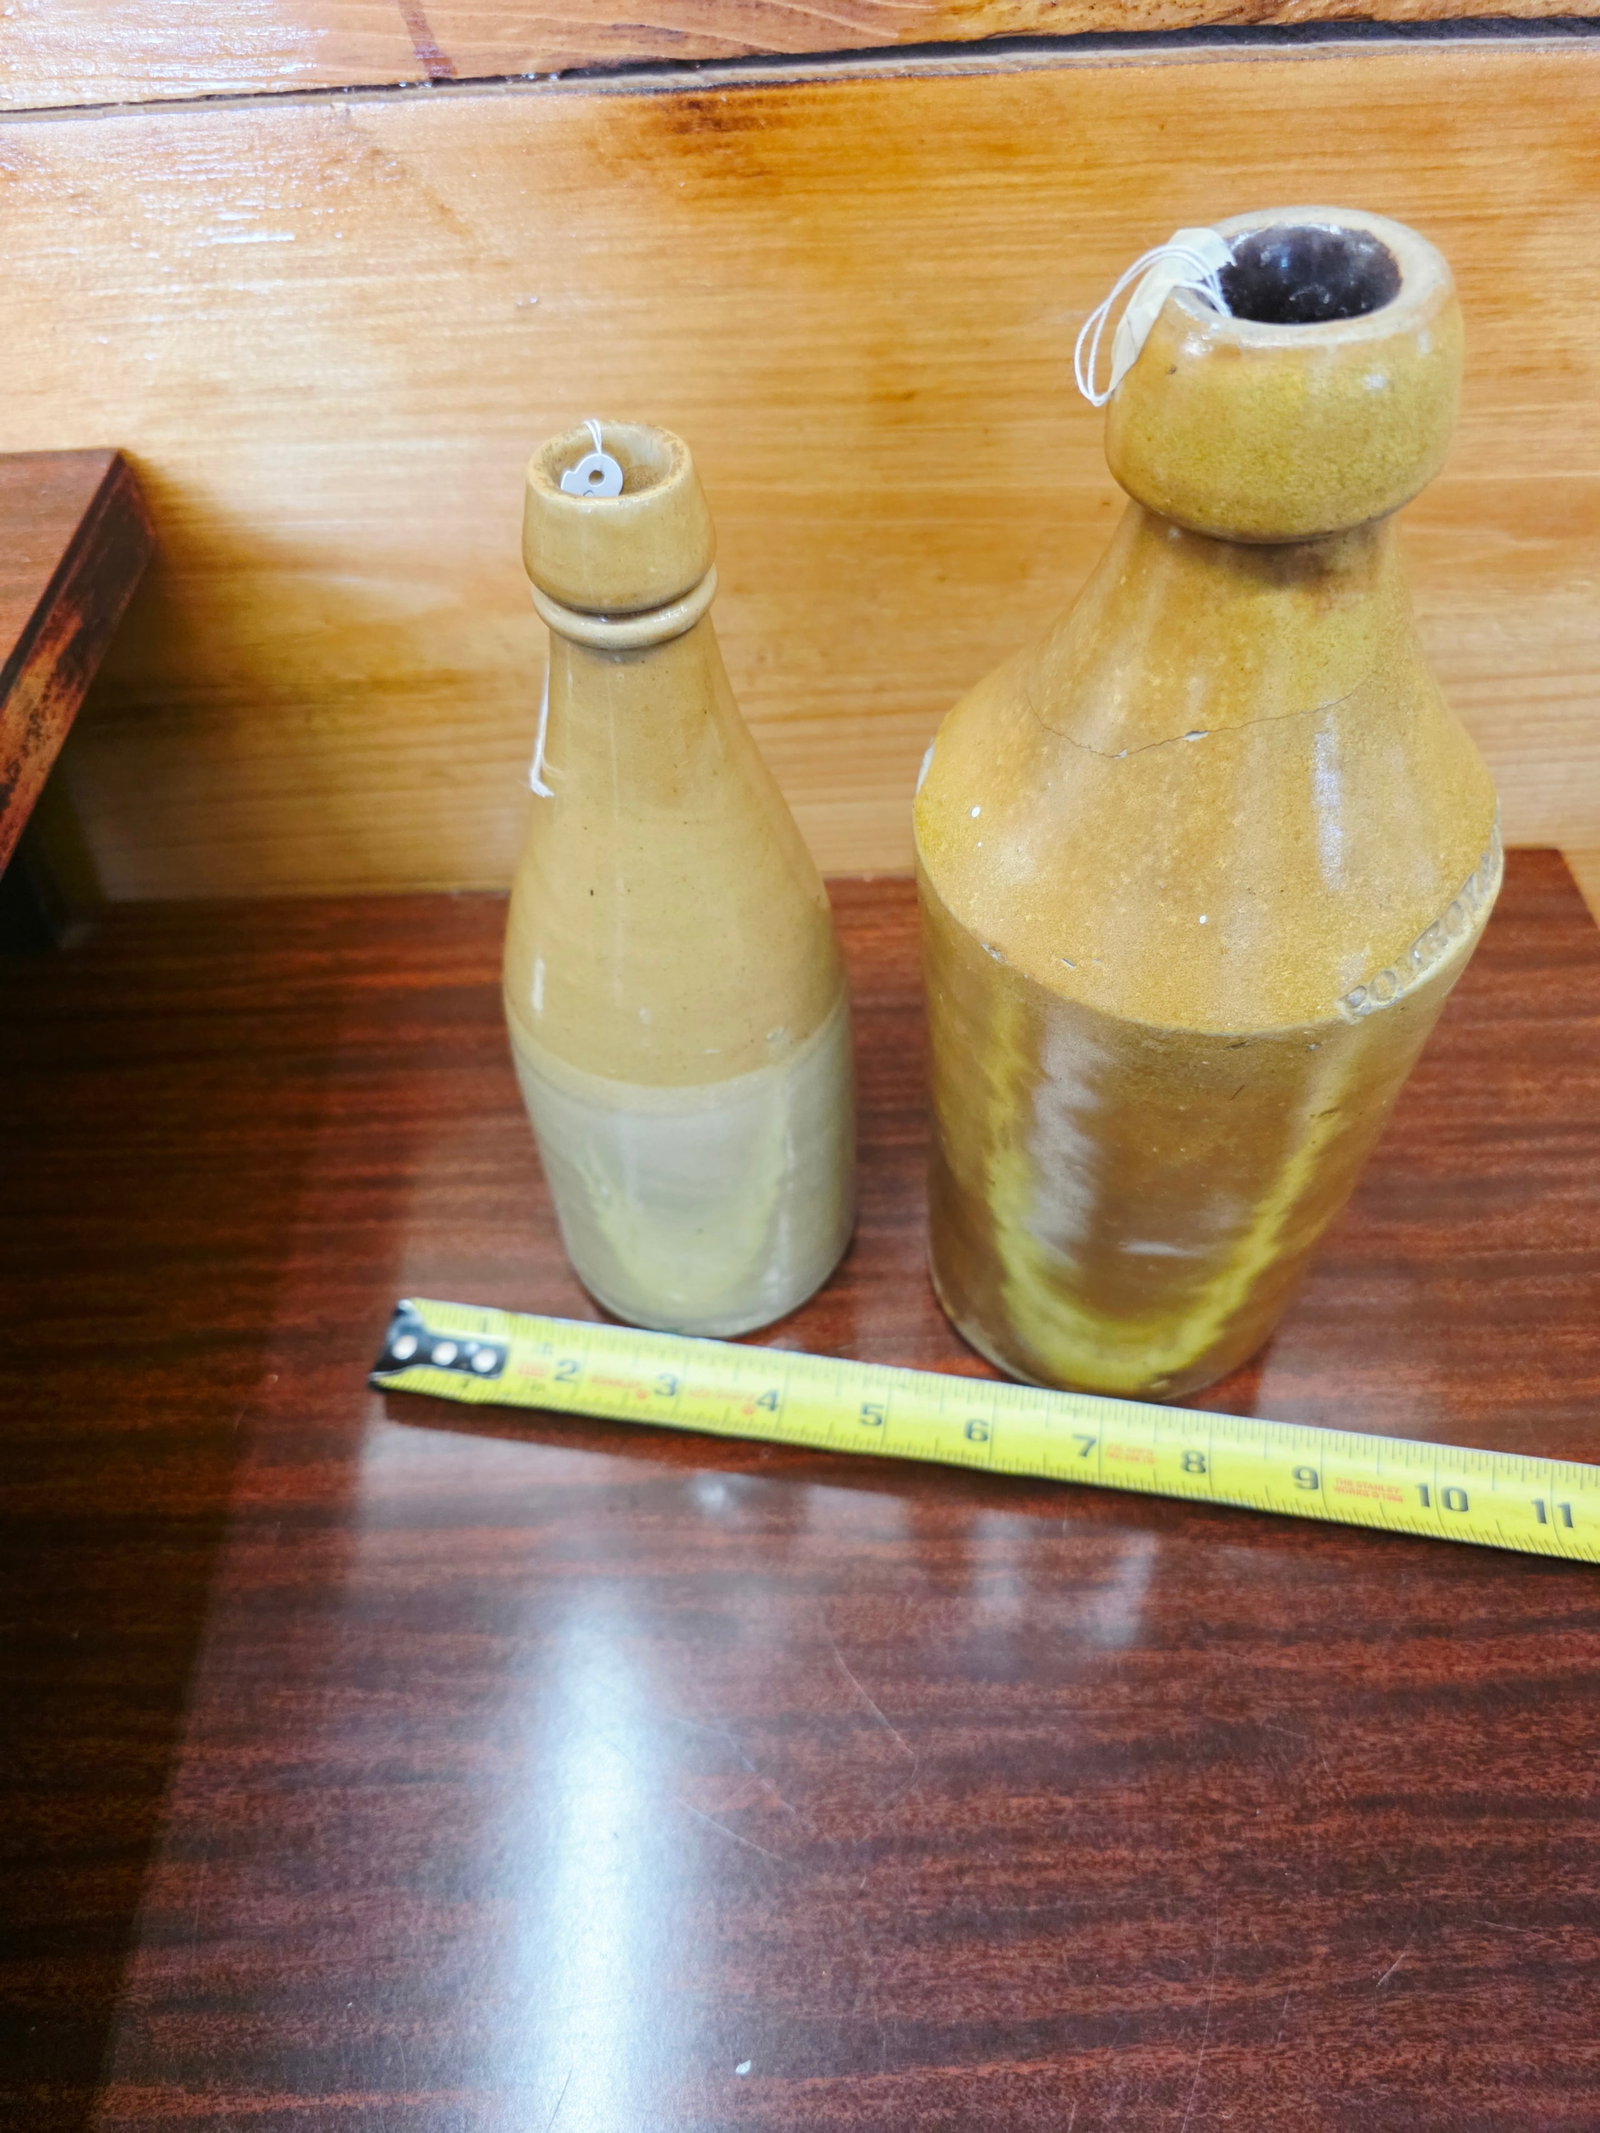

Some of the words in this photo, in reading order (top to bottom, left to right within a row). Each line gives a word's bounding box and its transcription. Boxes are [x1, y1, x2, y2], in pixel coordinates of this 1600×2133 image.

[554, 1358, 580, 1381] 2
[654, 1373, 679, 1397] 3
[756, 1389, 781, 1411] 4
[860, 1403, 884, 1426] 5
[965, 1419, 989, 1442] 6
[1073, 1434, 1097, 1457] 7
[1182, 1450, 1206, 1473] 8
[1293, 1466, 1319, 1490] 9
[1416, 1483, 1469, 1512] 10
[1531, 1498, 1574, 1528] 11
[1356, 1480, 1400, 1494] STANLEY
